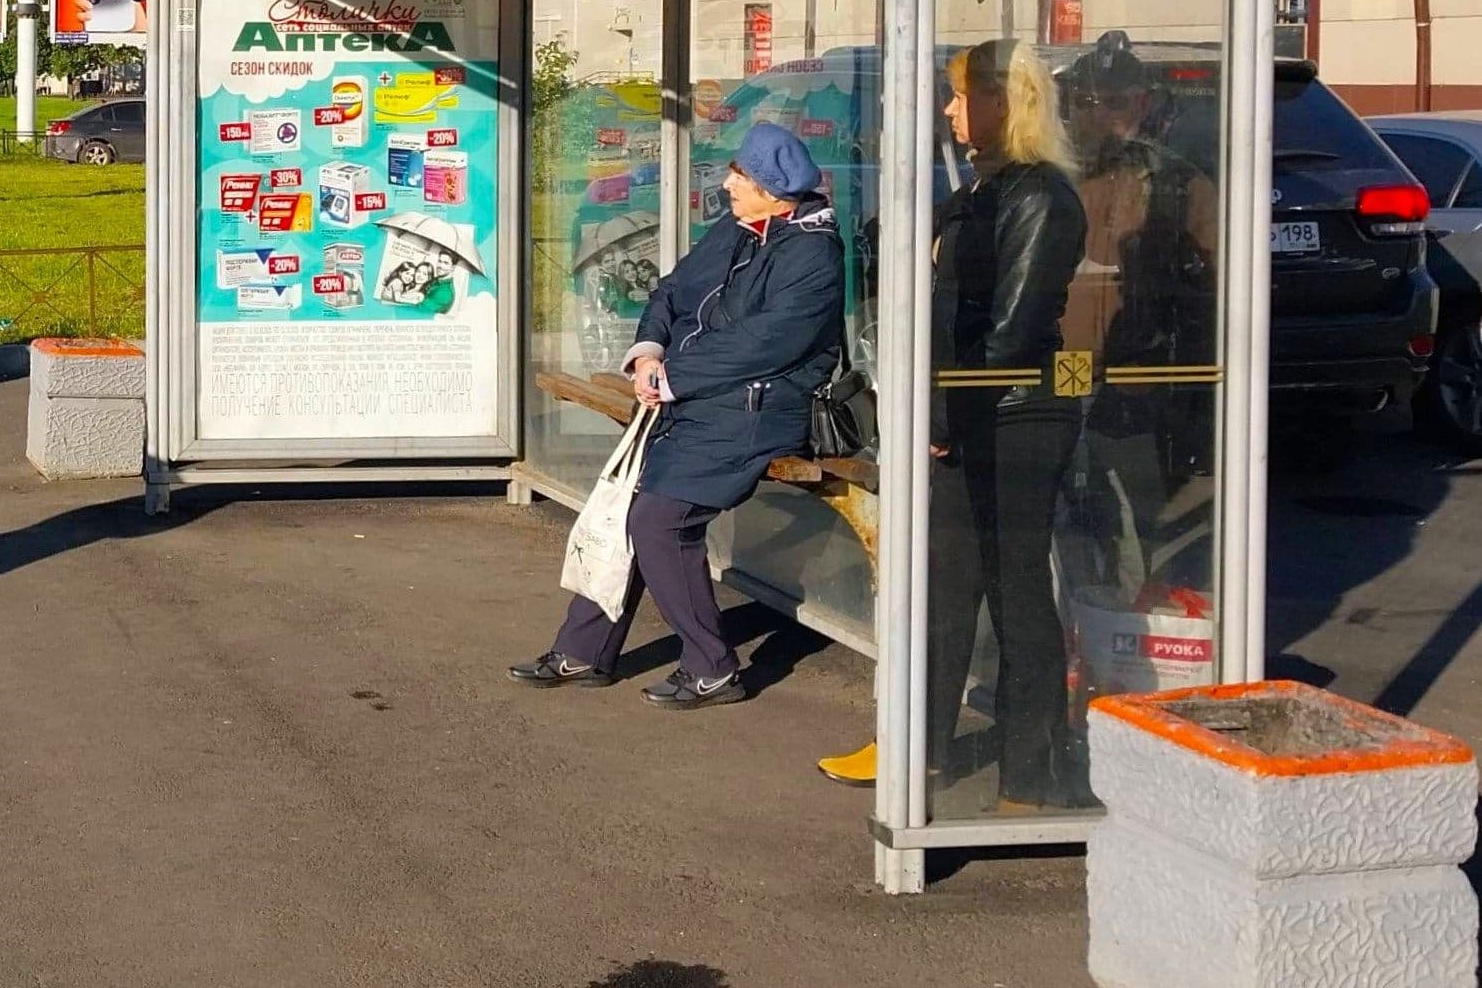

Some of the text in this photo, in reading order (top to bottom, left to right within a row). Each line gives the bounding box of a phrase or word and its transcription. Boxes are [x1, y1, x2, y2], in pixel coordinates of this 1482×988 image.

[276, 23, 300, 32] сеть
[302, 23, 374, 33] социальных
[230, 62, 314, 77] СЕЗОН СКИДОК
[436, 69, 465, 83] -30%
[316, 110, 343, 123] -20%
[429, 131, 455, 144] -20%
[274, 171, 299, 184] -30%
[357, 195, 384, 208] -15%
[1282, 224, 1313, 242] 198
[270, 258, 297, 272] -20%
[317, 278, 343, 291] -20%
[394, 371, 473, 393] НЕОБХОДИМО
